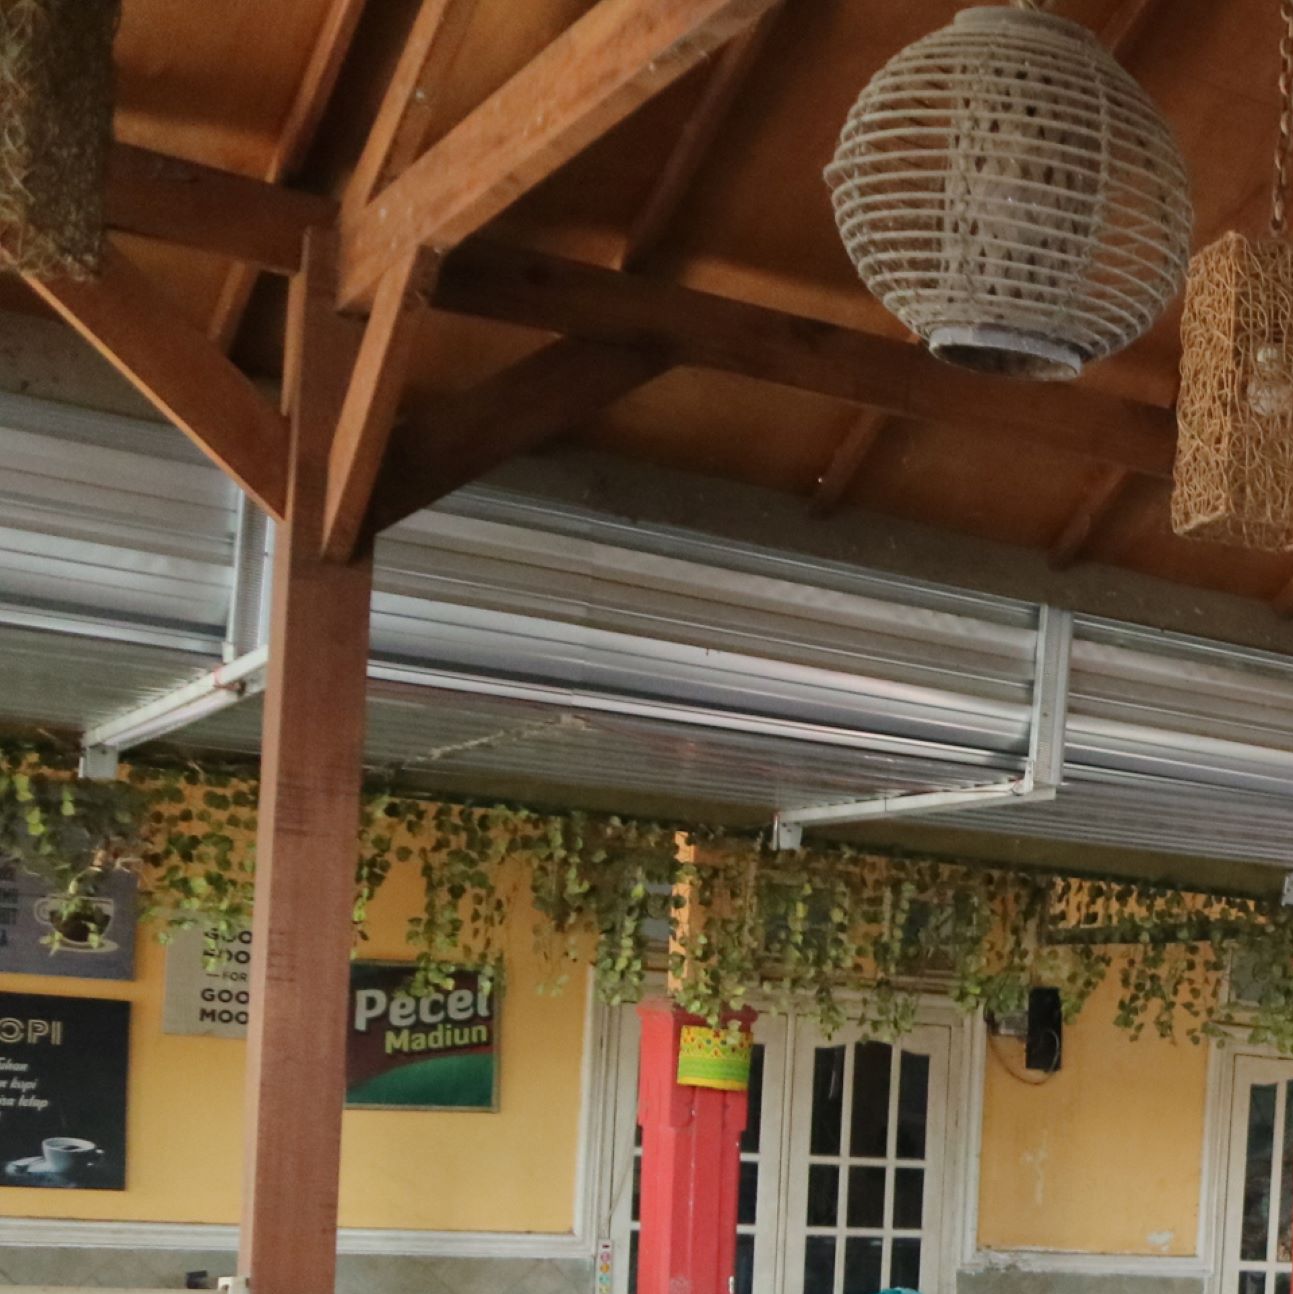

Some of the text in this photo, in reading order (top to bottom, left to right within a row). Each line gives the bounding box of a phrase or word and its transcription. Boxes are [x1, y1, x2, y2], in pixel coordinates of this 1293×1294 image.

[201, 988, 249, 1004] GOO
[354, 975, 490, 1031] Pecel
[199, 1008, 249, 1025] MOO
[0, 1017, 63, 1045] OPI
[384, 1023, 489, 1055] Madiun
